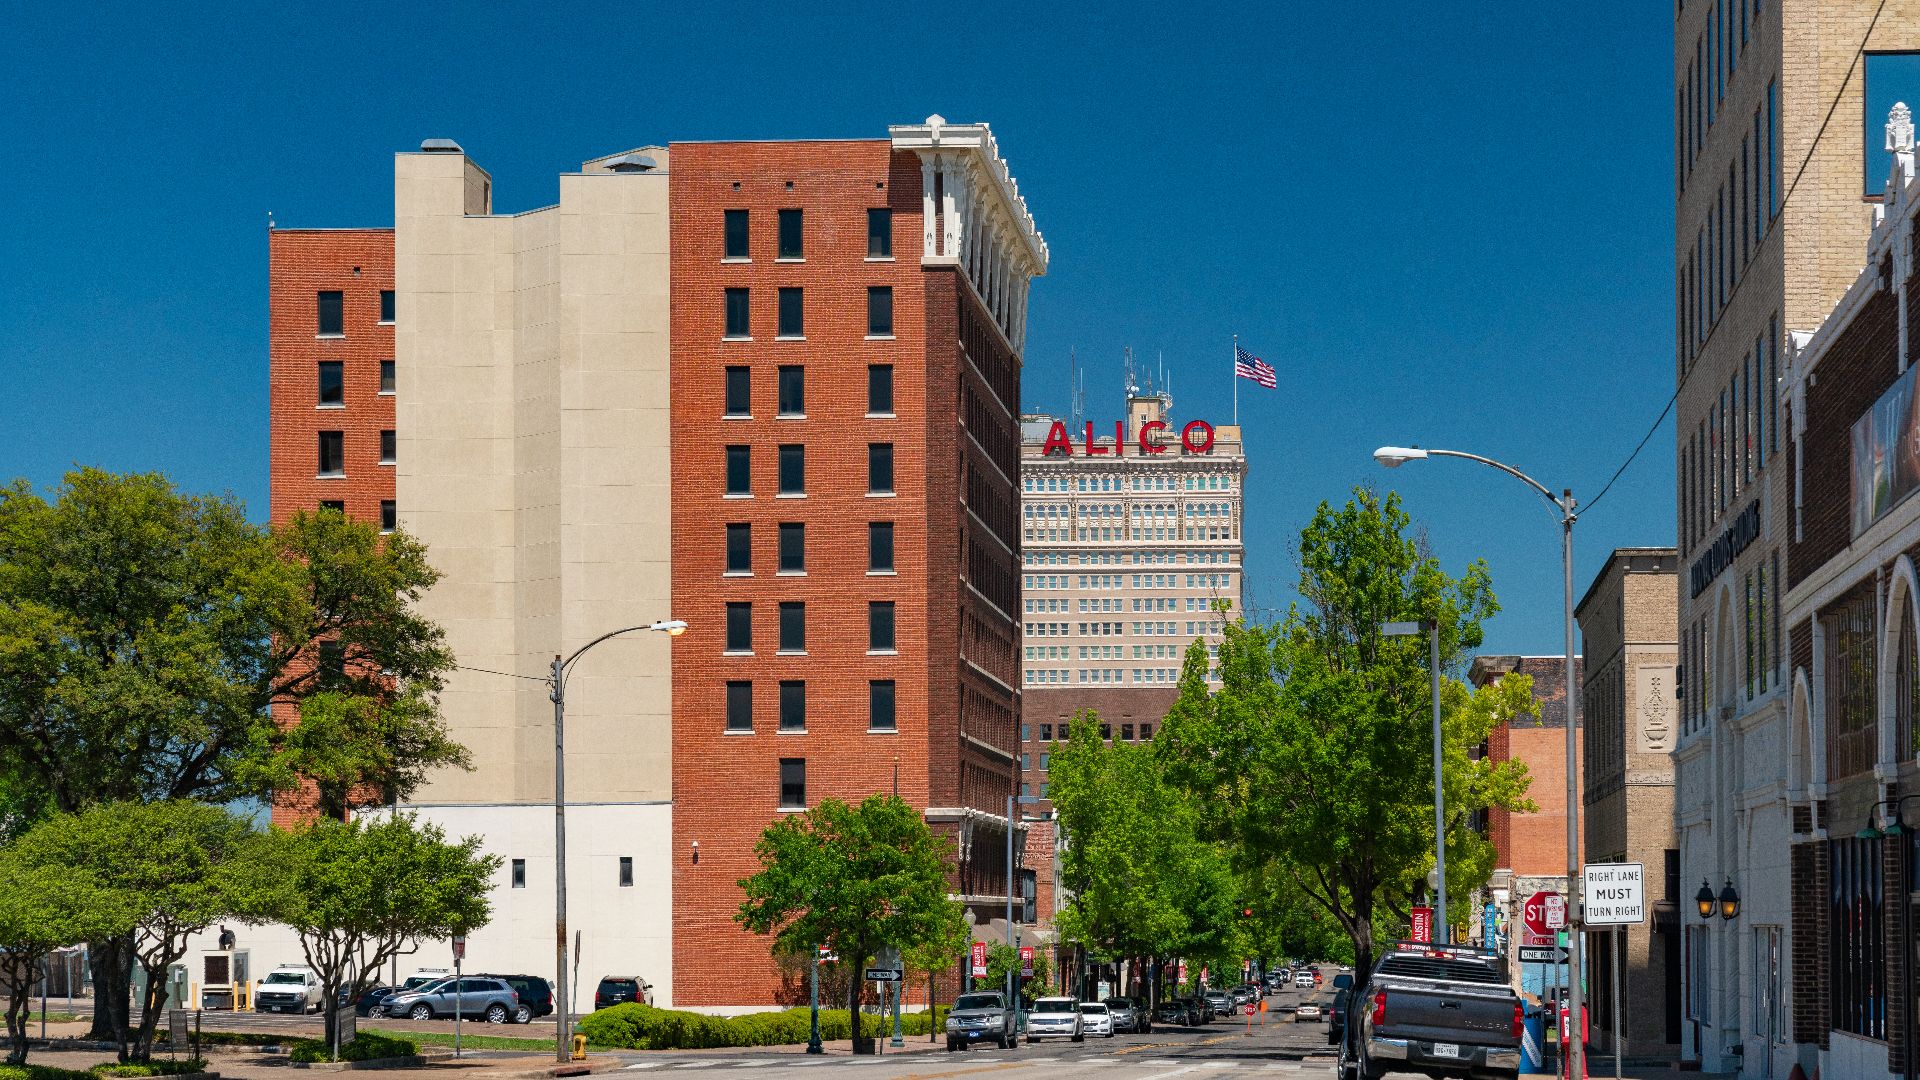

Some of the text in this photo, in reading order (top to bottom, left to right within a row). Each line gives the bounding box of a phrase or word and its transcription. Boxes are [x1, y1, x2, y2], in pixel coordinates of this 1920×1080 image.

[1042, 420, 1214, 456] ALICO
[1588, 871, 1639, 882] RIGHT LANE
[1596, 888, 1632, 900] MUST
[1588, 905, 1641, 917] TURN RIGHT
[1414, 913, 1424, 942] AUSTIN
[1523, 951, 1555, 959] ONE WAY
